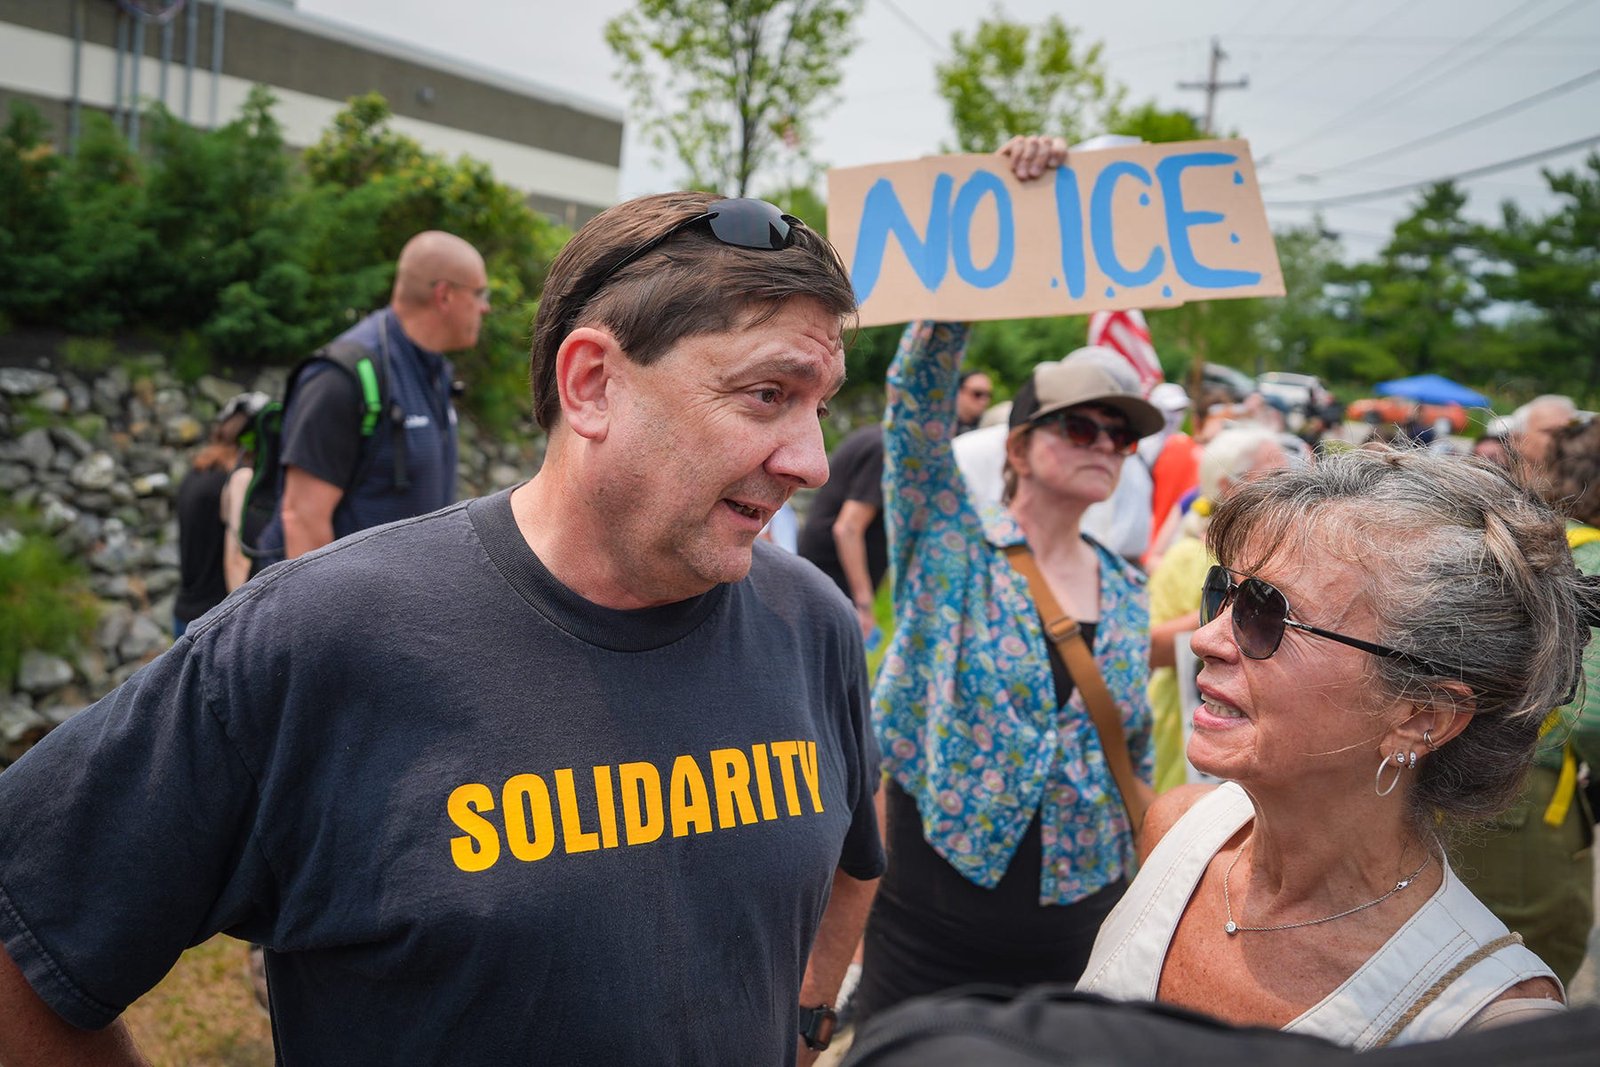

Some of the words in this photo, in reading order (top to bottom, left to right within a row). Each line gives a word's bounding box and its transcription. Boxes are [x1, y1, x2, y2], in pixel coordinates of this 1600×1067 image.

[852, 169, 1014, 304] NO
[1055, 151, 1261, 299] ICE
[447, 740, 824, 873] SOLIDARITY
